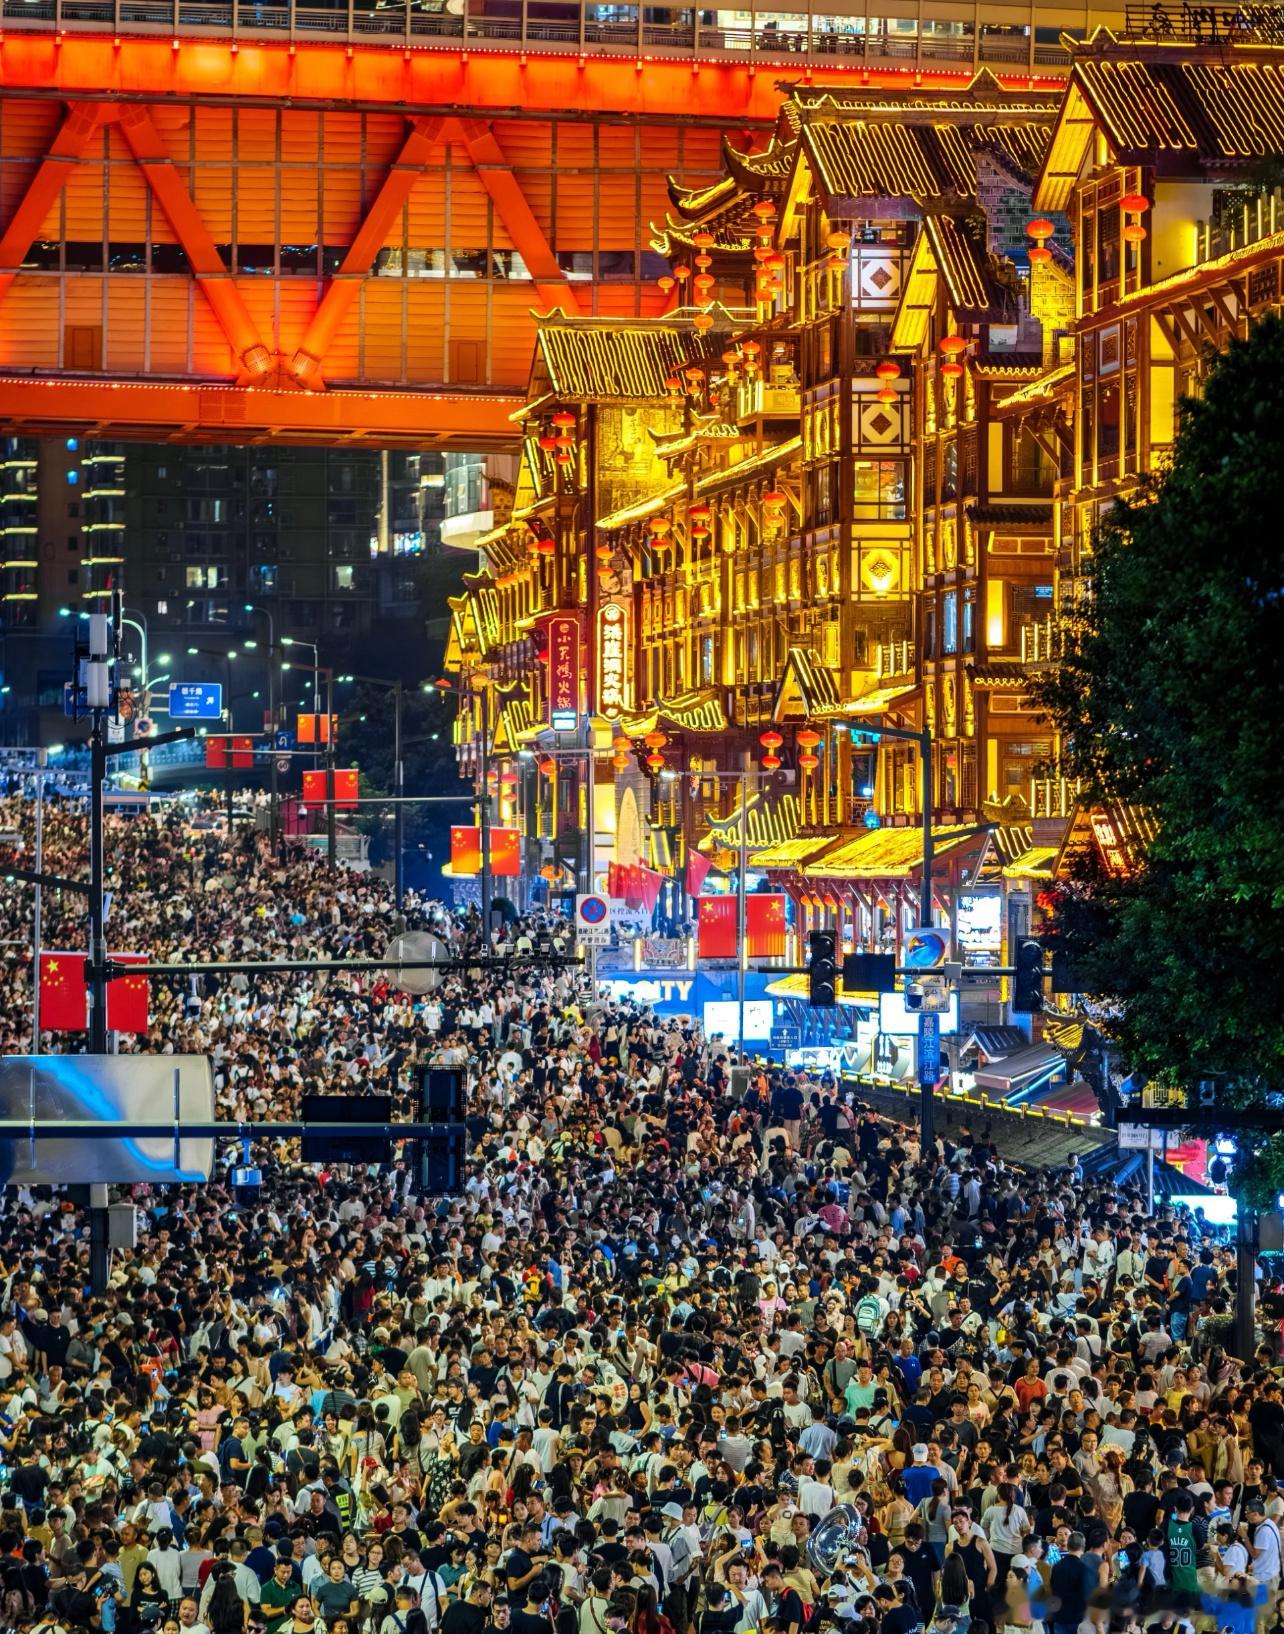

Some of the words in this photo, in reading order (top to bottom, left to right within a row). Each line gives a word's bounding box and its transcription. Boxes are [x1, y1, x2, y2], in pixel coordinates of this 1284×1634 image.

[923, 1016, 935, 1081] 嘉陵江滨江路
[1170, 1537, 1189, 1547] ALLEN
[1170, 1548, 1192, 1568] 20
